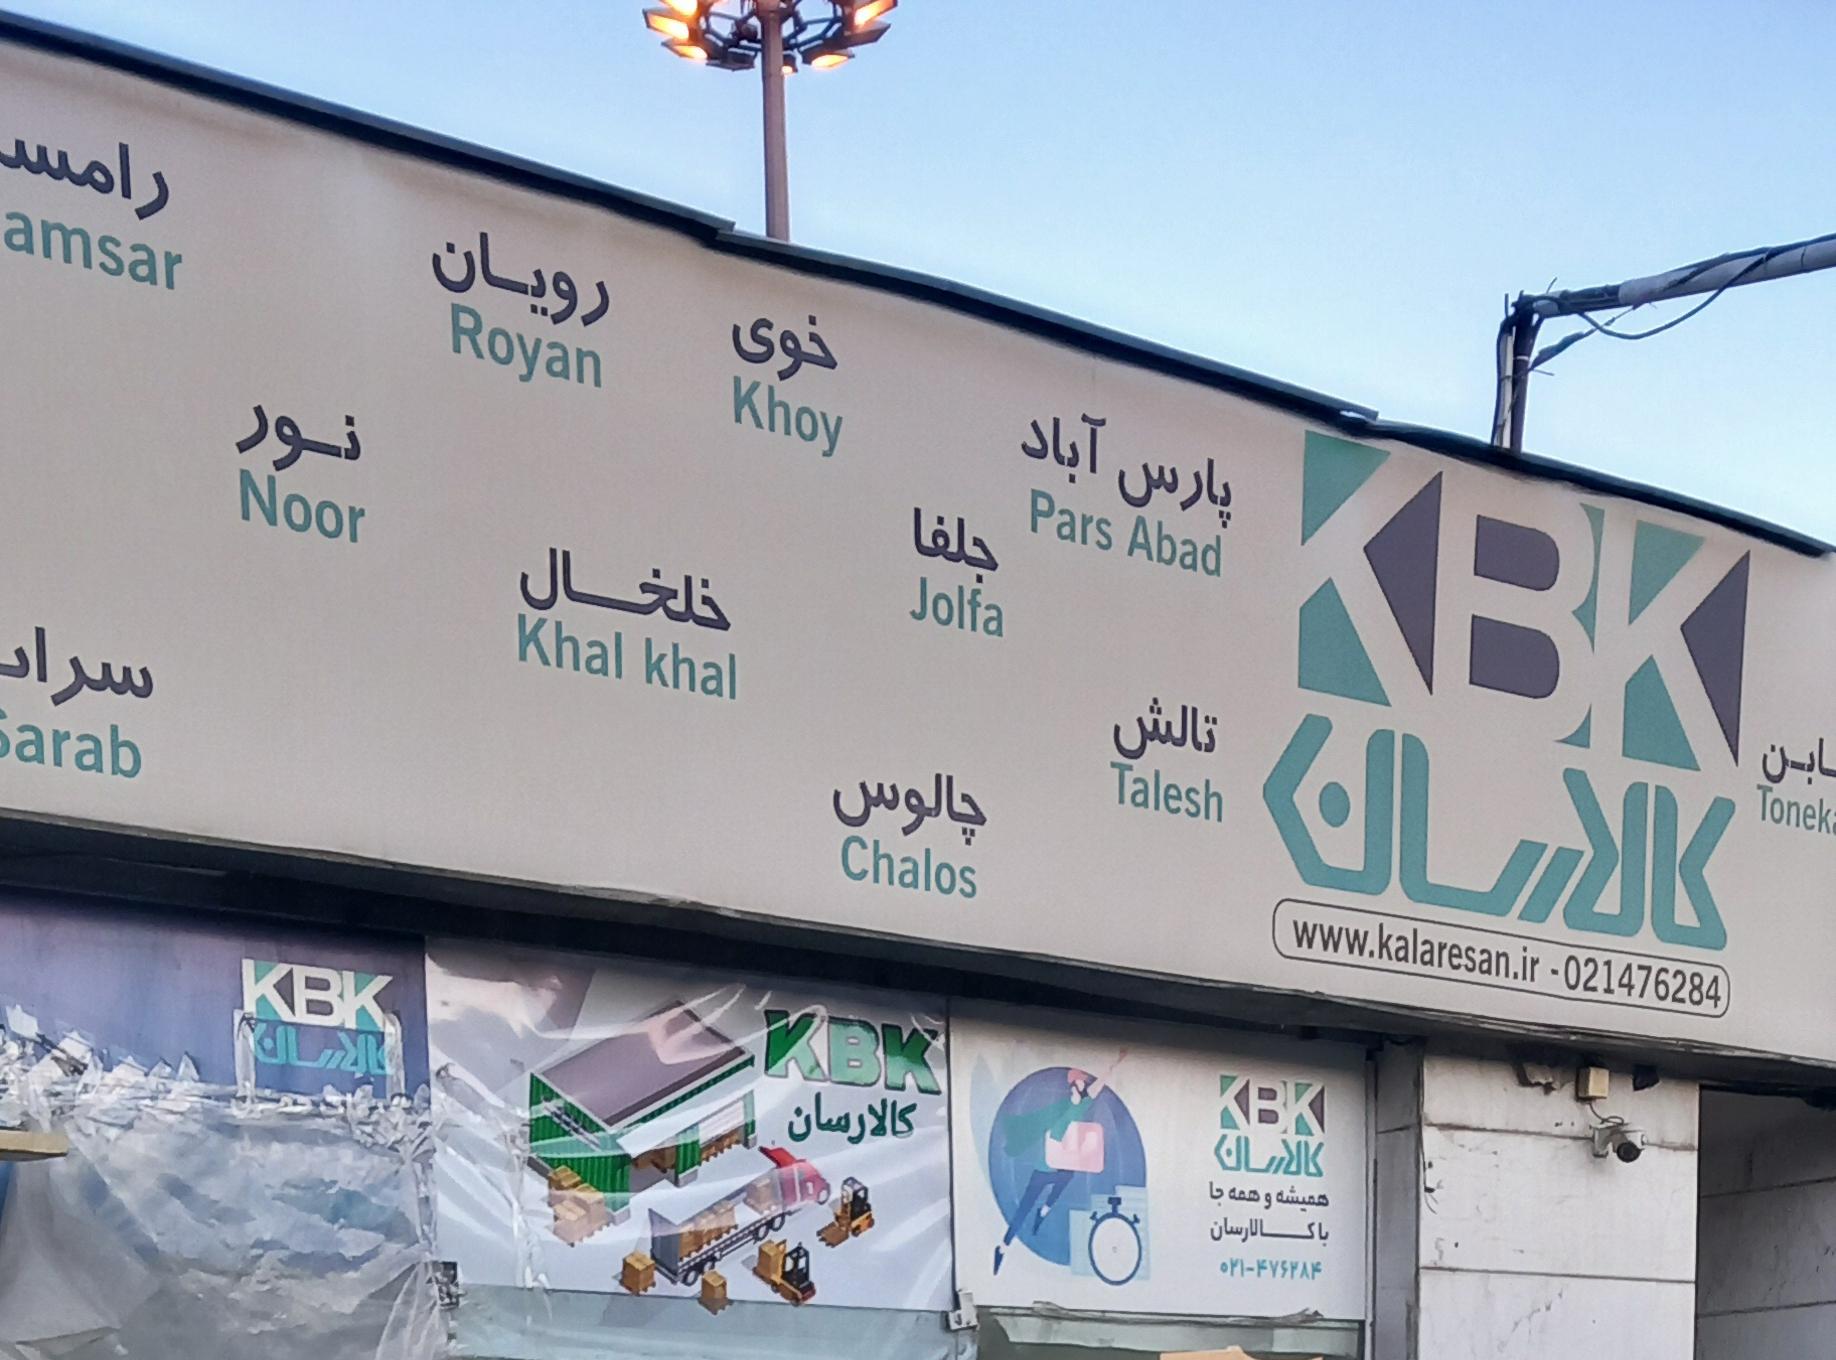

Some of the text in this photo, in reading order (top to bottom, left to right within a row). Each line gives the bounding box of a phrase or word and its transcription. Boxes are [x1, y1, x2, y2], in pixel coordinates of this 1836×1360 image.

[0, 139, 169, 220] رامس
[3, 211, 182, 290] amsar
[432, 232, 609, 327] رویان
[450, 303, 602, 388] Royan
[732, 315, 838, 381] خوی
[235, 405, 361, 470] نور
[733, 375, 842, 457] Khoy
[239, 468, 366, 544] Noor
[1021, 413, 1232, 528] پارس آباد
[913, 507, 1000, 582] جلفا
[1030, 488, 1222, 578] Pars Abad
[520, 547, 731, 632] خلخال
[909, 577, 1004, 637] Jolfa
[1297, 429, 1750, 772] KBK
[517, 613, 736, 700] Khal khal
[1113, 697, 1217, 760] تالش
[1762, 737, 1836, 785] ابن
[833, 773, 987, 846] چالوس
[1110, 761, 1223, 823] Talesh
[1756, 784, 1836, 836] Tonek
[840, 836, 977, 898] Chalos
[1293, 919, 1540, 983] www.kalaresan.ir
[241, 958, 394, 1032] KBK
[764, 1009, 942, 1095] KBK
[788, 1091, 917, 1144] کالارسان
[1219, 1074, 1325, 1136] KBK
[1209, 1181, 1329, 1212] همیشه و همه جا
[1318, 1222, 1329, 1247] با
